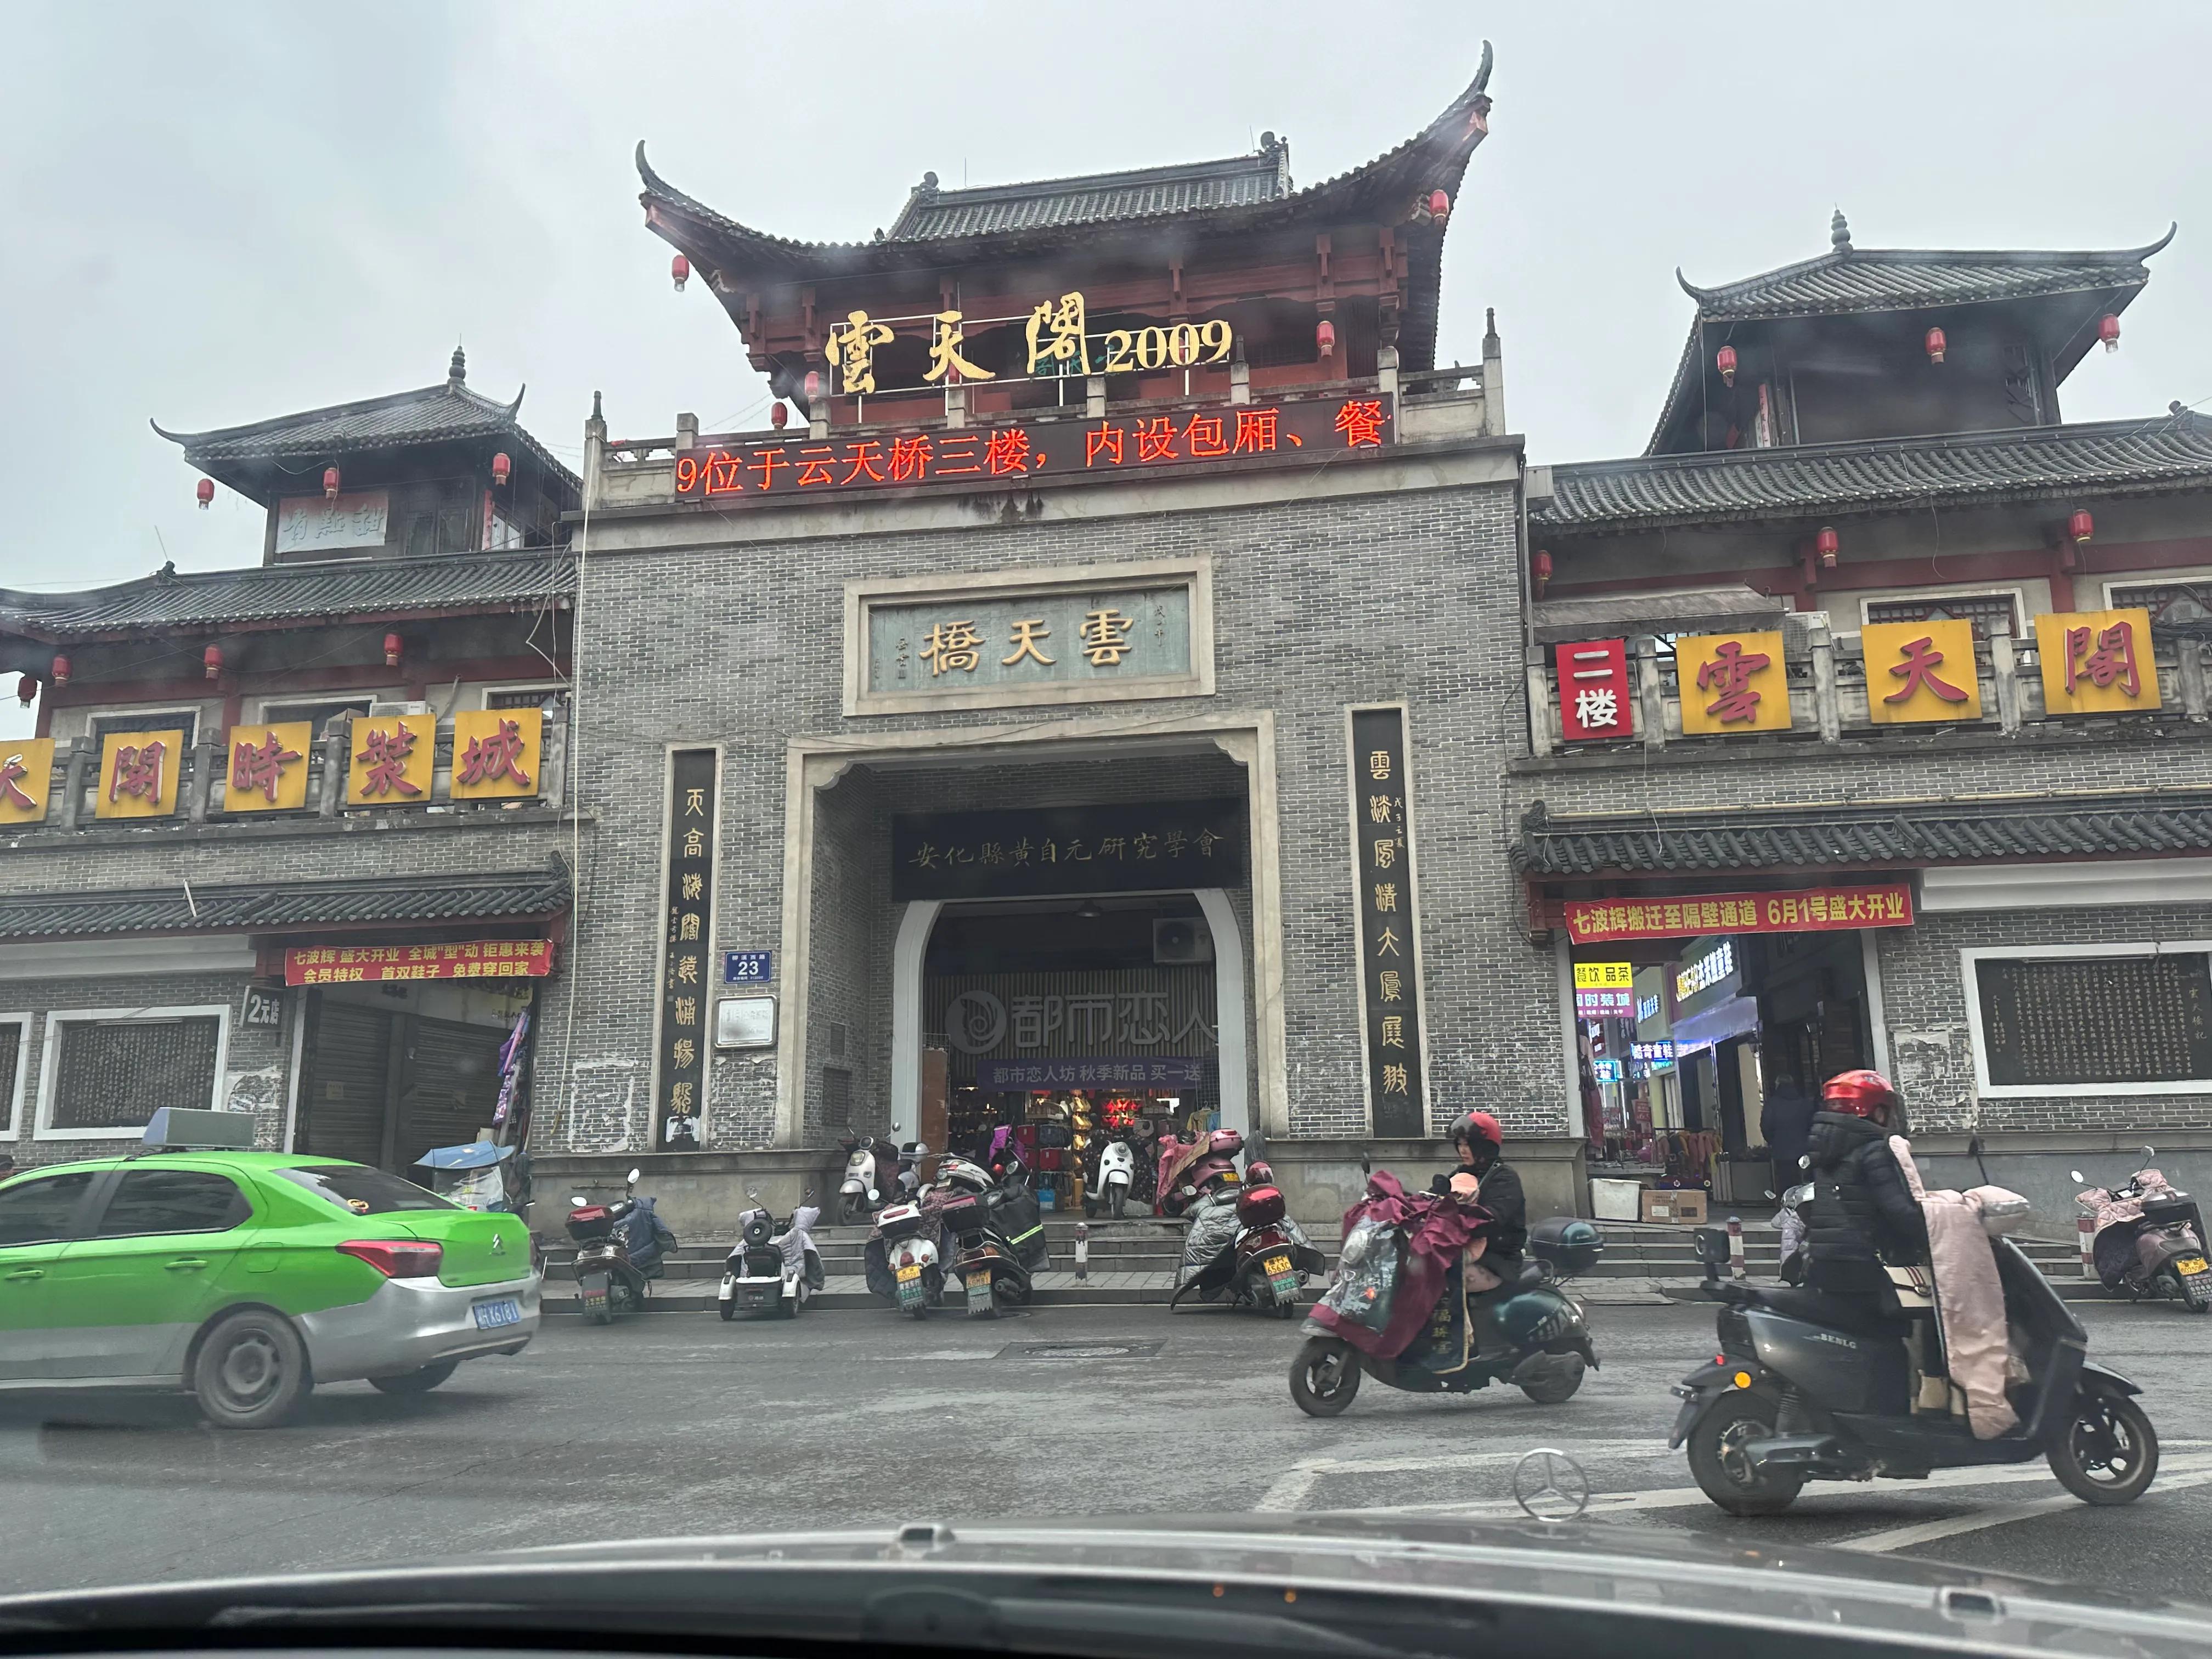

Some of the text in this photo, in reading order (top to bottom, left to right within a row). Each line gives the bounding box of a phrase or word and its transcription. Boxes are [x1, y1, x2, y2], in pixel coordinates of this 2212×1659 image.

[825, 292, 1232, 394] 雲天閣 2009
[1696, 621, 2141, 723] 雲天閣
[1573, 650, 1618, 729] 二楼
[1572, 893, 1905, 935] 七波辉搬迁至隔壁通道 6月1号盛大开业
[294, 949, 336, 966] 七波辉
[340, 947, 400, 964] 盛大开业
[482, 941, 545, 958] 钜惠来袭
[303, 961, 529, 983] 会员特权 首双鞋子 免费穿回家
[738, 961, 759, 975] 23
[1577, 967, 1629, 982] 餐饮 品茶
[247, 994, 280, 1025] 2元店
[1012, 990, 1218, 1049] 都市恋人
[992, 1065, 1075, 1084] 都市恋人坊
[1080, 1064, 1146, 1082] 秋季新品
[1267, 1261, 1290, 1274] 6563C
